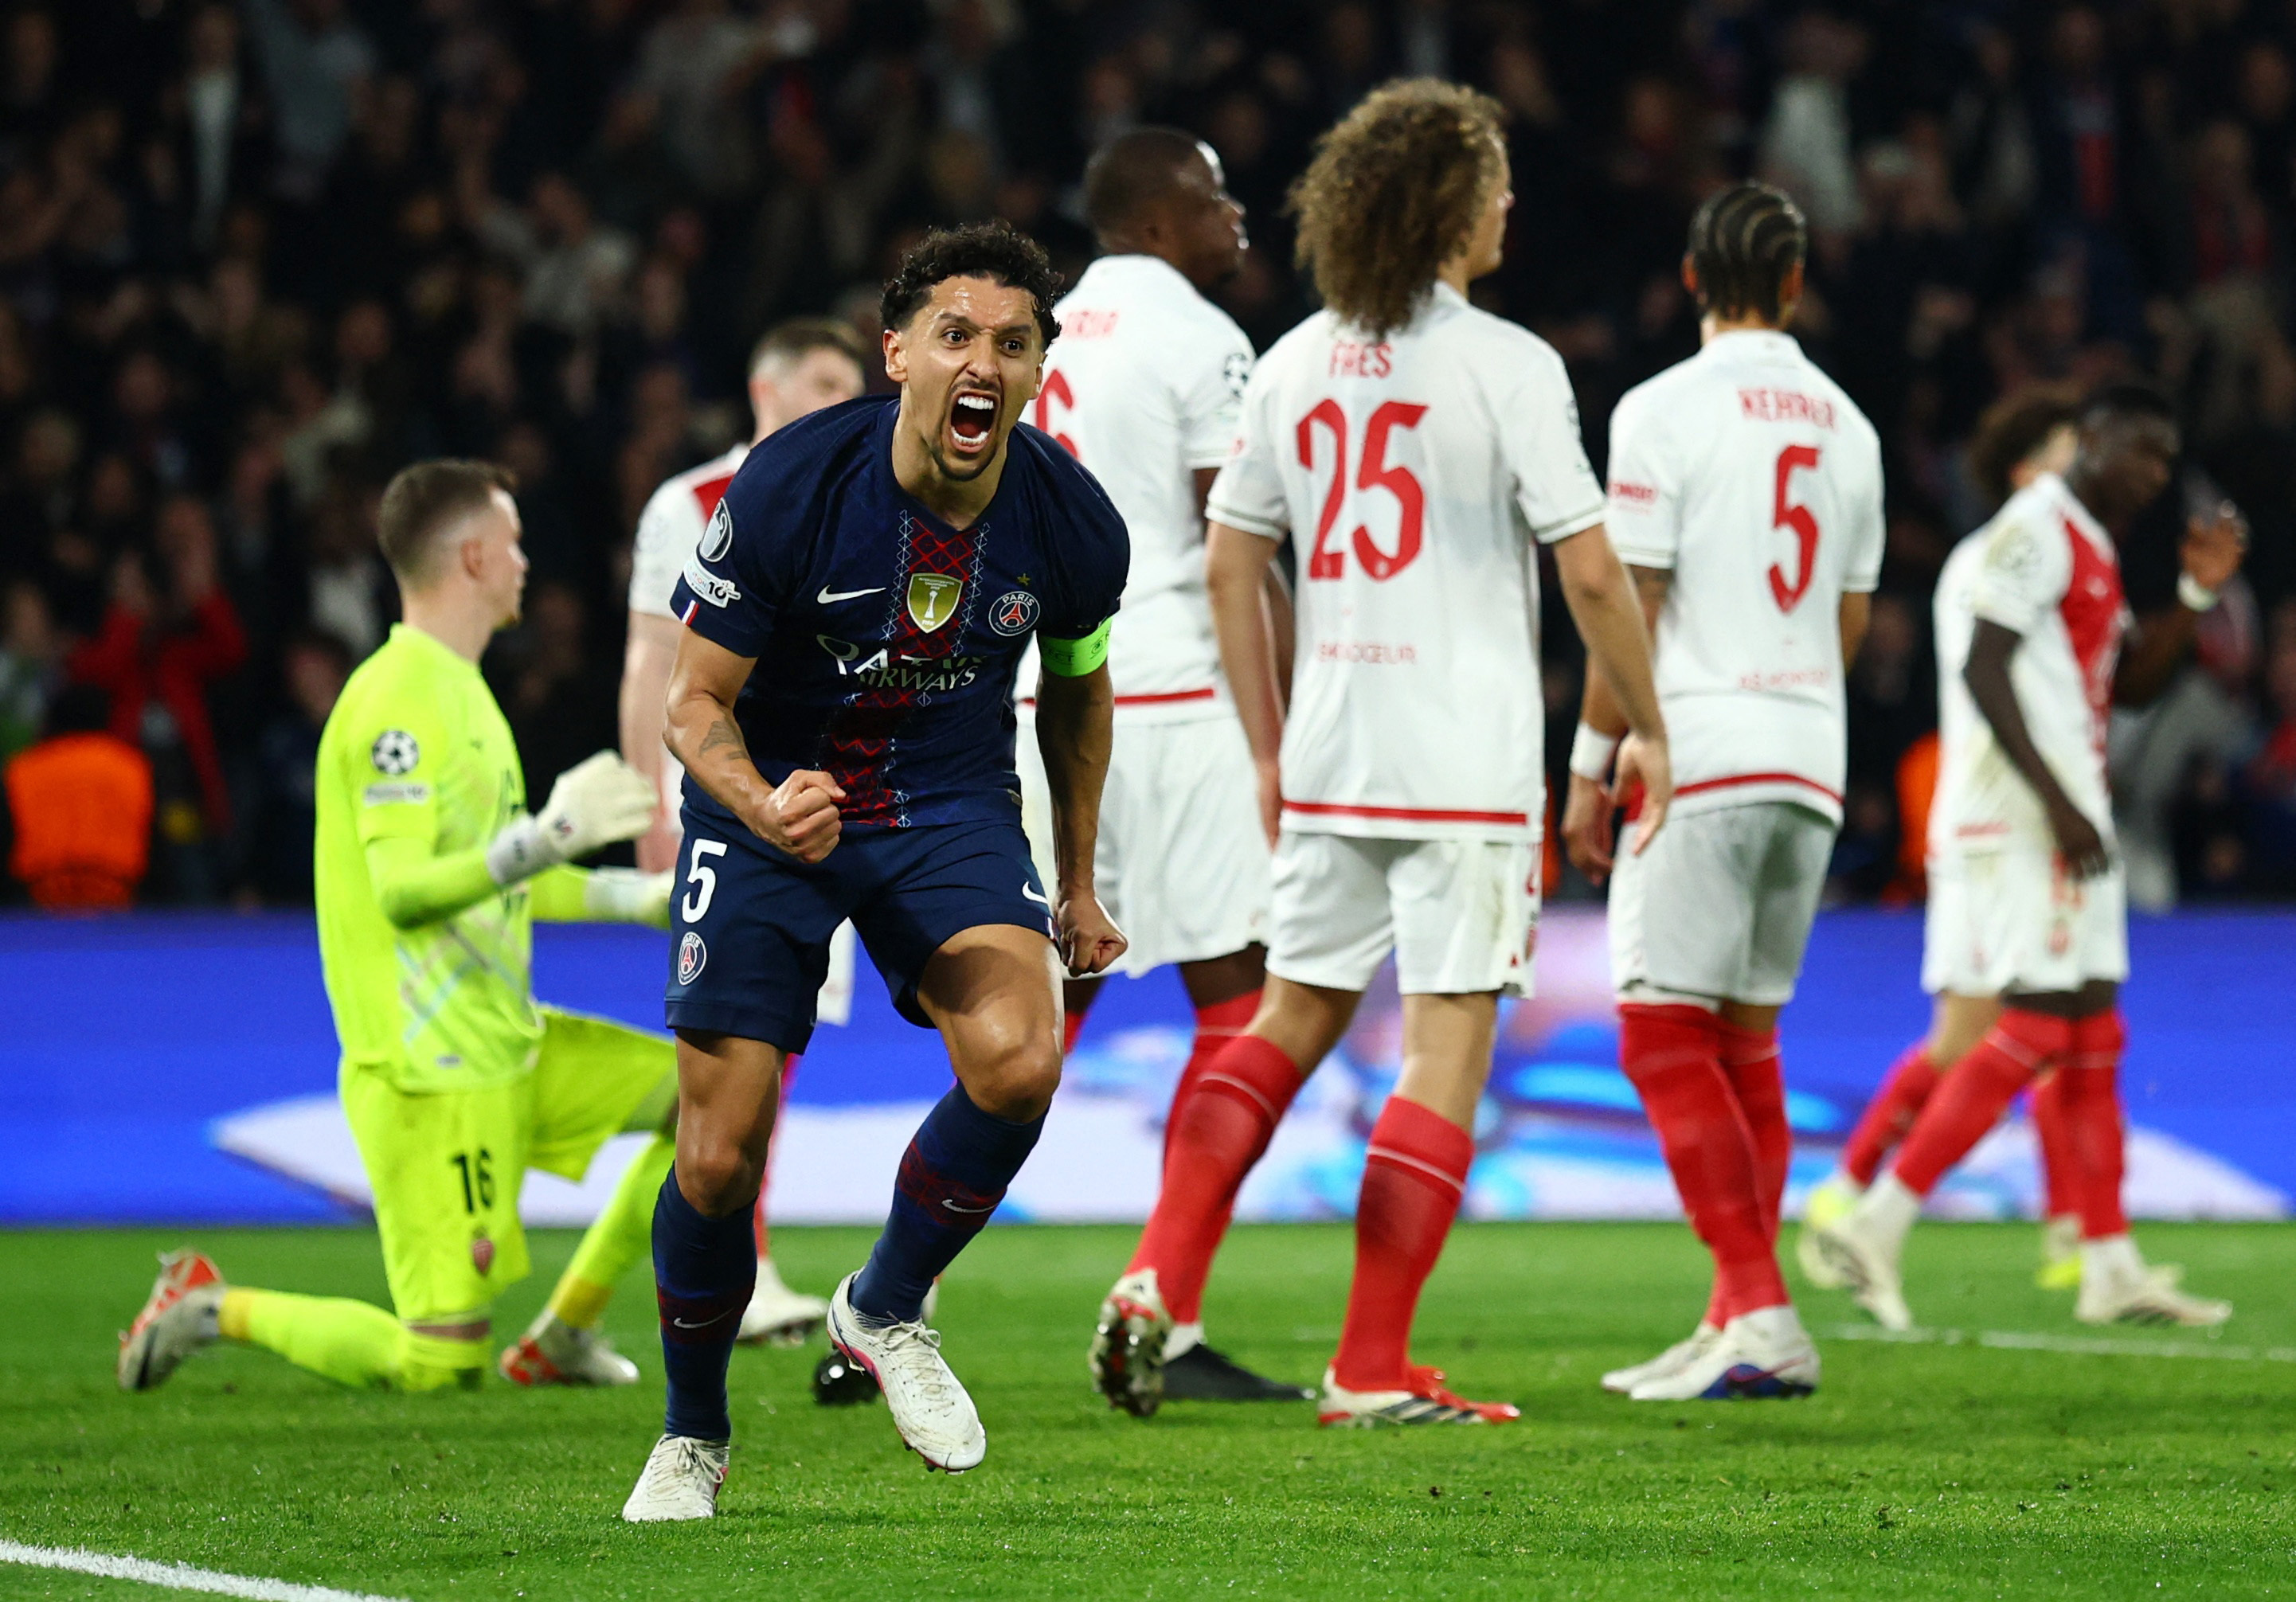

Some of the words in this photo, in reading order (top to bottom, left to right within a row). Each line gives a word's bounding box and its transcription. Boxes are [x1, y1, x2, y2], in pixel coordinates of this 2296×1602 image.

[1297, 398, 1430, 582] 25
[1766, 443, 1821, 616] 5
[1002, 593, 1035, 607] PARIS
[682, 838, 728, 924] 5
[450, 1147, 495, 1214] 16
